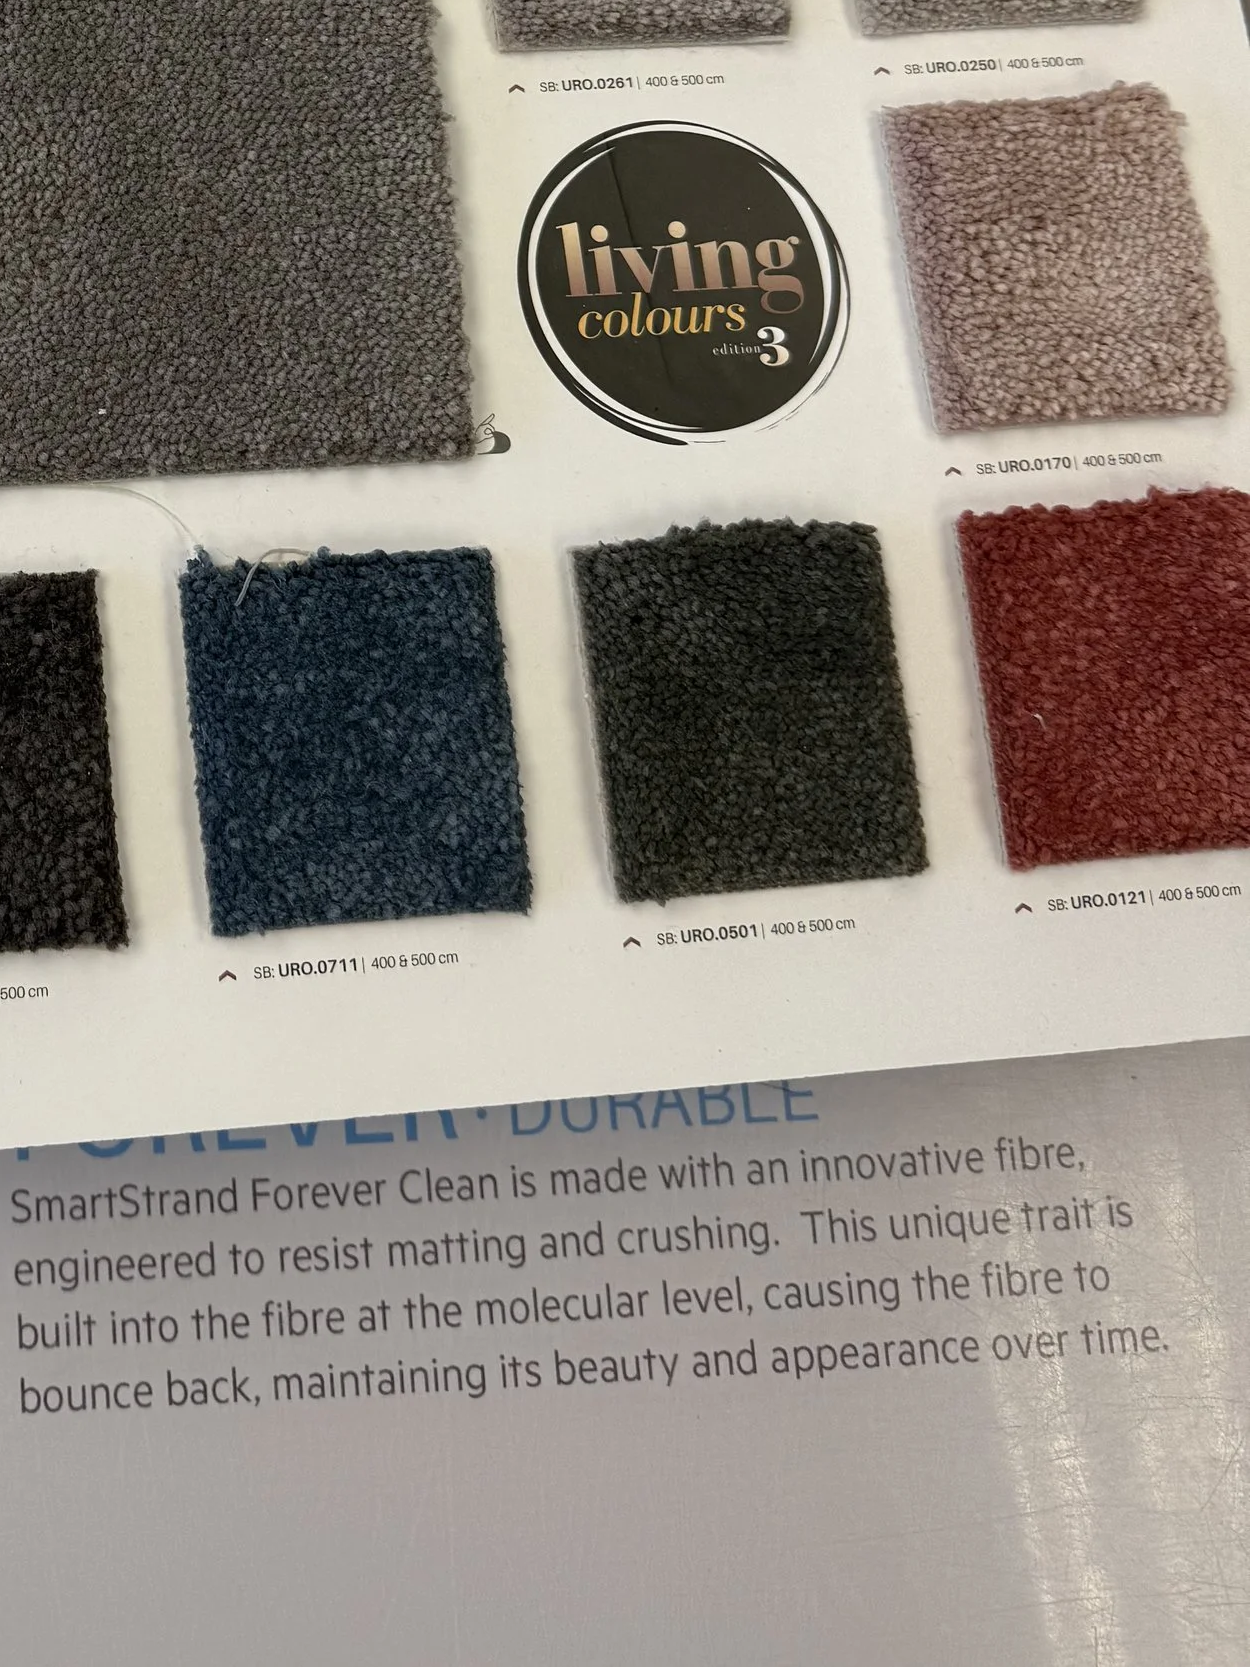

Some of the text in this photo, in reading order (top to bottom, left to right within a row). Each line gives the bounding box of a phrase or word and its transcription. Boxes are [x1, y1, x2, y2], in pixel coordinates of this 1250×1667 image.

[539, 75, 633, 93] SB: URO.0261
[556, 221, 804, 315] living
[578, 292, 745, 339] colours
[712, 326, 789, 367] edition 3
[976, 455, 1072, 475] SB: URO.0170
[1047, 885, 1242, 912] SB: URO.0121 400 & 500 cm
[656, 918, 856, 946] SB: URO.0501 400 & 500 cm
[253, 952, 459, 980] SB: URO.0711 400 & 500 cm
[0, 986, 26, 1000] 500
[28, 986, 49, 998] cm
[11, 1136, 1087, 1224] SmartStrand Forever Clean is made with an innovative fibre,
[14, 1195, 1133, 1293] engineered to resist matting and crushing. This unique trait is
[18, 1256, 1110, 1351] built into the fibre at the molecular level, causing the fibre to
[20, 1320, 1169, 1414] bounce back, maintaining its beauty and appearance over time.
